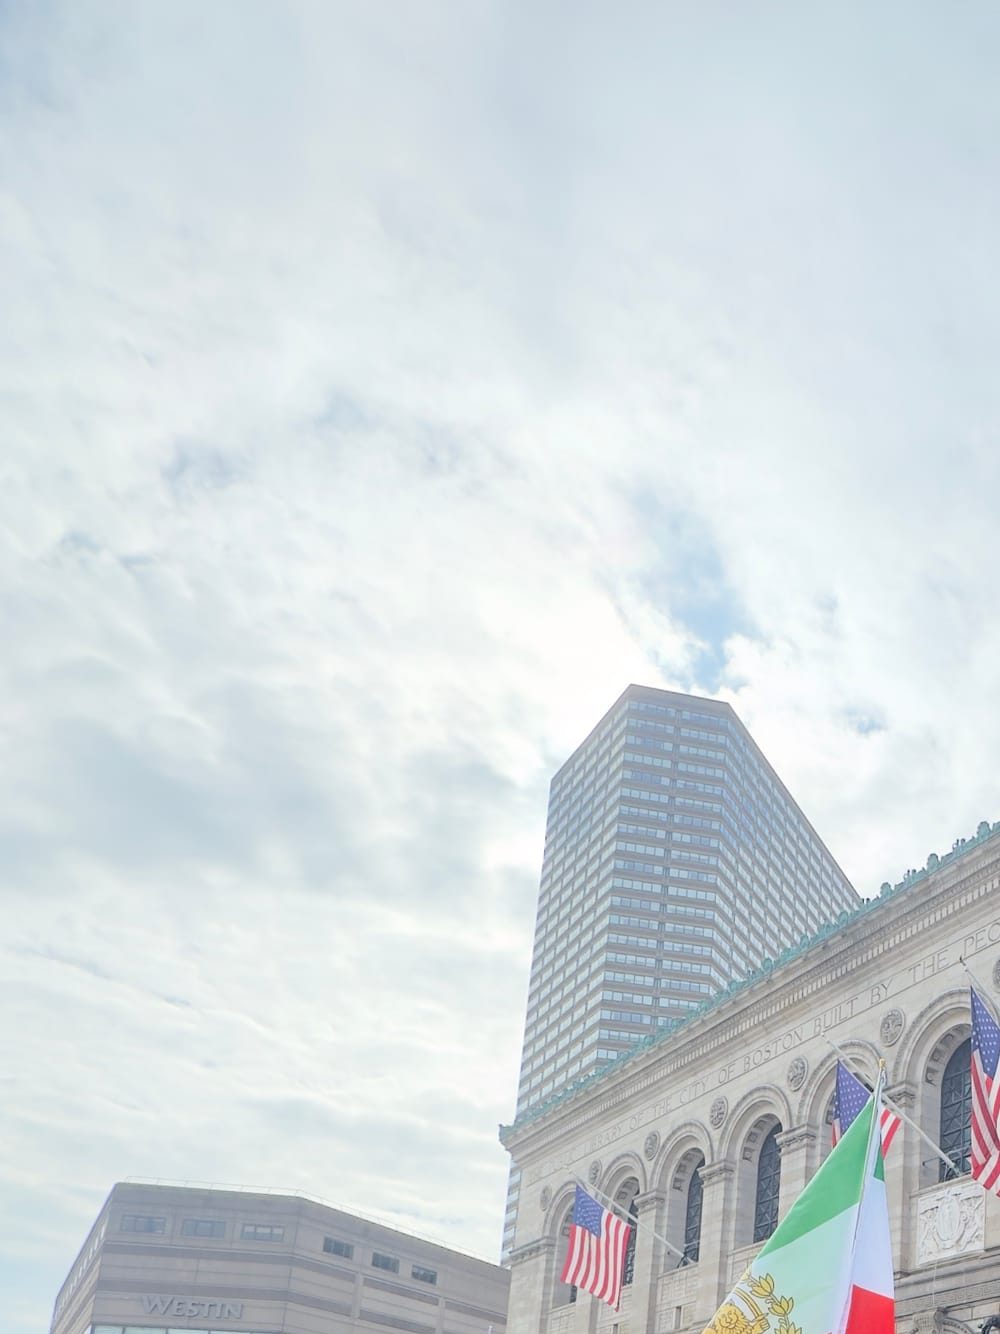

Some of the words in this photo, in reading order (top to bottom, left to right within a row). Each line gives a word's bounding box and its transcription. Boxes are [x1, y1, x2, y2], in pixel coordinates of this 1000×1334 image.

[679, 1080, 708, 1104] CITY
[718, 1061, 736, 1083] OF
[743, 1028, 804, 1073] BOSTON
[813, 997, 859, 1035] BUILT
[871, 978, 894, 1004] BY
[907, 949, 949, 982] THE
[141, 1295, 244, 1320] WESTIN
